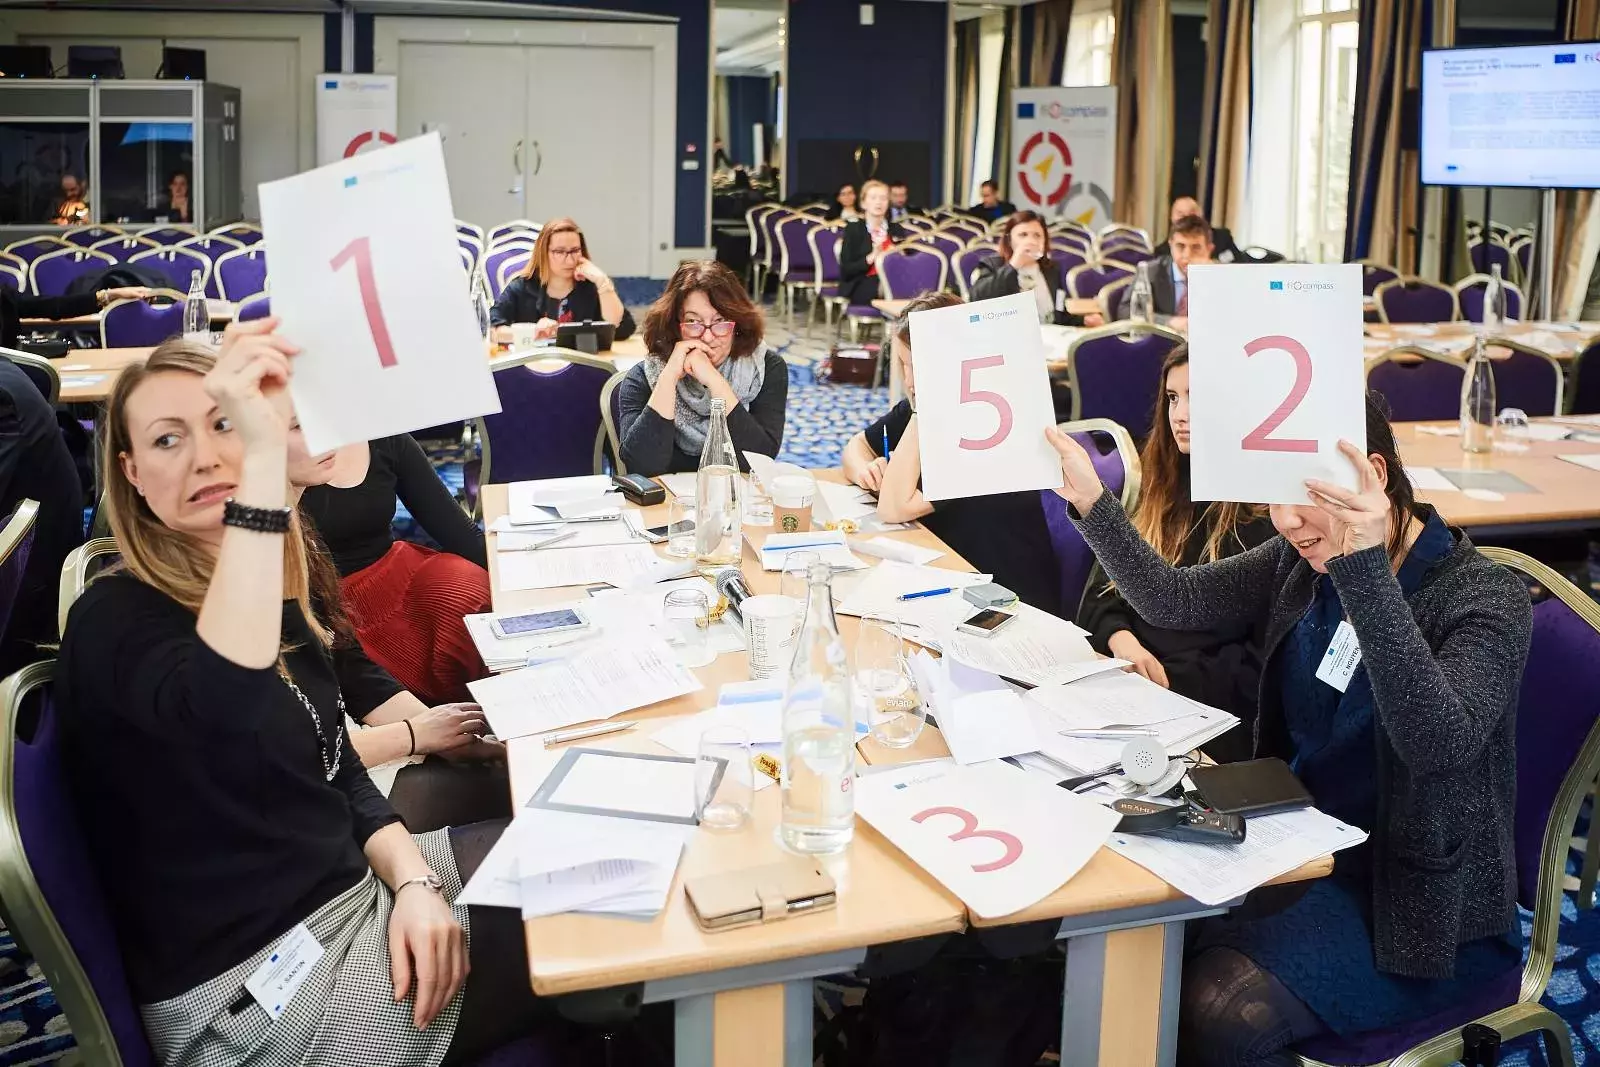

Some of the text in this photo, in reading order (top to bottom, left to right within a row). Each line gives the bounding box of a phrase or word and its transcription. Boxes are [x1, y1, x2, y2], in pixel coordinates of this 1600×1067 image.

[330, 237, 398, 369] 1
[957, 355, 1013, 452] 5
[1241, 335, 1319, 454] 2
[910, 806, 1024, 873] 3
